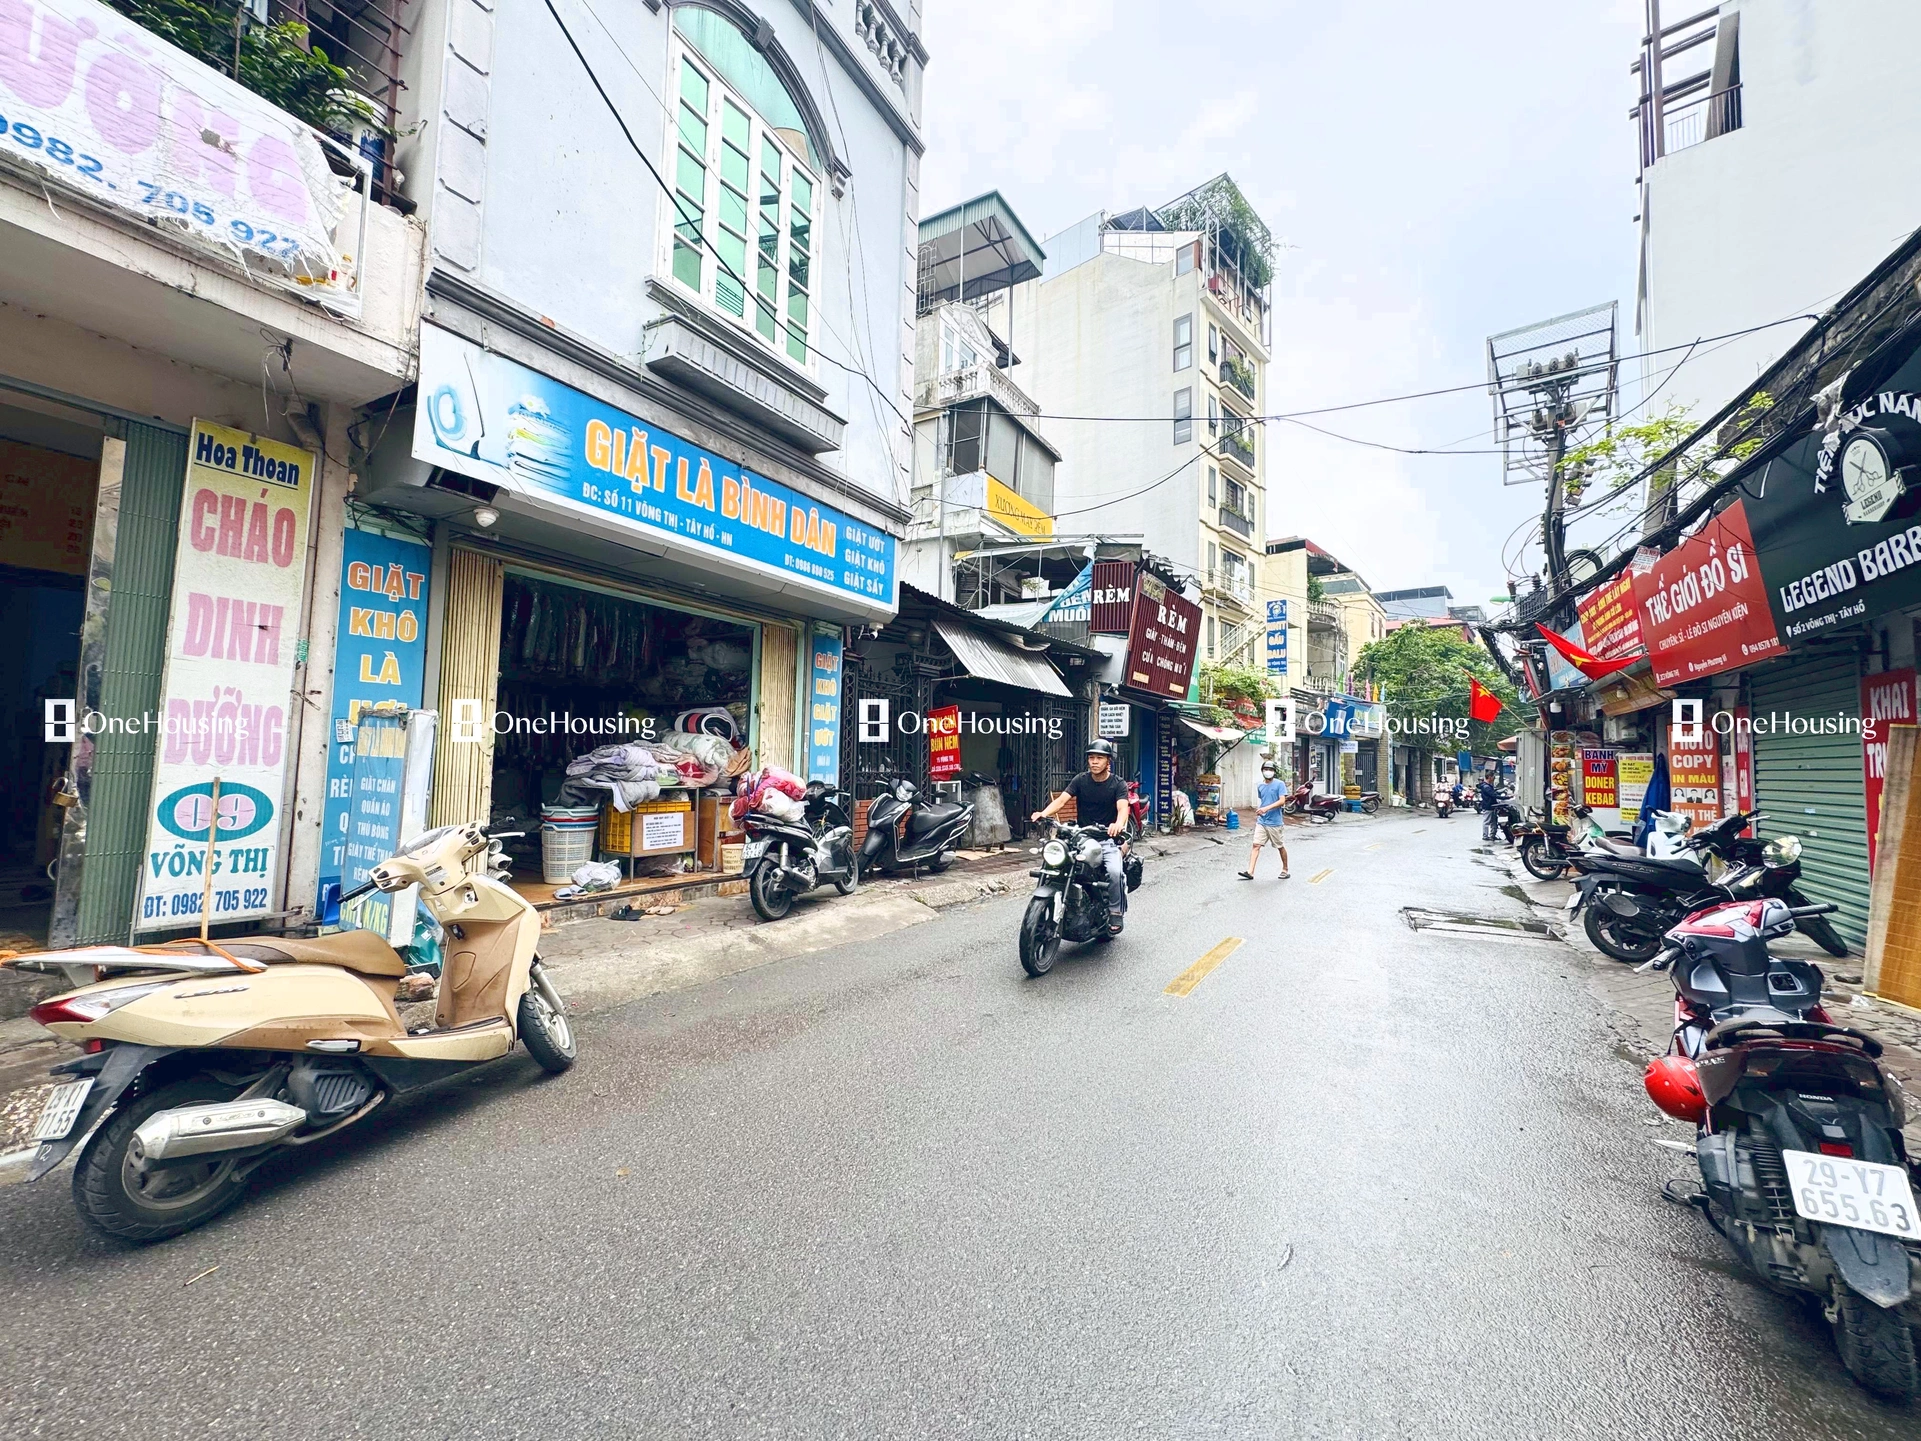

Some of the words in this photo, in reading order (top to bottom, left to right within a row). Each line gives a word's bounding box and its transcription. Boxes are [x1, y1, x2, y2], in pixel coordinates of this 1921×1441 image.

[0, 115, 116, 188] 982.
[138, 180, 216, 226] 705
[196, 432, 237, 469] Hoa
[242, 445, 300, 485] Thoan
[585, 418, 671, 494] GIẶT
[676, 455, 715, 513] LÀ
[721, 474, 787, 539] BÌNH
[790, 507, 837, 558] DÂN
[190, 488, 297, 568] CHÁO
[582, 481, 601, 502] ĐC:
[603, 488, 619, 508] SỐ
[620, 496, 632, 513] 11
[635, 500, 662, 523] VÕNG
[663, 510, 679, 531] THỊ
[686, 518, 701, 536] TÂY
[721, 531, 733, 547] HN
[844, 525, 867, 550] GIẶT
[868, 532, 886, 553] ƯỚT
[844, 548, 867, 569] GIẶT
[867, 556, 885, 576] KHÔ
[348, 561, 425, 602] GIẶT
[843, 570, 866, 591] GIẶT
[866, 577, 885, 596] SẤY
[1093, 584, 1130, 604] RÈM
[1645, 572, 1672, 627] THẾ
[1670, 564, 1702, 615] GIỚI
[1726, 542, 1749, 584] SI
[1780, 559, 1857, 613] LEGEND
[183, 592, 284, 665] DINH
[349, 607, 419, 643] KHÔ
[1157, 604, 1188, 634] RÈM
[1806, 618, 1824, 630] VÕNG
[1838, 606, 1853, 620] TÂY
[359, 651, 402, 685] LÀ
[815, 652, 838, 674] GIẶT
[816, 678, 837, 697] KHÔ
[1870, 681, 1910, 722] KHAI
[163, 685, 284, 768] DƯỠNG
[813, 702, 837, 725] GIẶT
[1672, 755, 1713, 769] COPY
[361, 774, 376, 795] GIẶT
[1585, 776, 1614, 789] DONER
[1672, 775, 1685, 784] IN
[1688, 773, 1716, 784] MÀU
[174, 793, 257, 832] 09
[382, 800, 391, 817] ÁO
[1585, 792, 1614, 805] KEBAB
[1698, 805, 1717, 821] THẺ
[358, 821, 371, 837] THÚ
[372, 823, 390, 840] BÔNG
[150, 843, 224, 879] VÕNG
[228, 847, 271, 880] THỊ
[143, 896, 167, 919] ĐT:
[215, 890, 241, 912] 705
[243, 888, 268, 910] 922
[1799, 1093, 1834, 1102] HONDA
[1803, 1159, 1885, 1197] 29-Y7
[1800, 1187, 1911, 1232] 655.63
